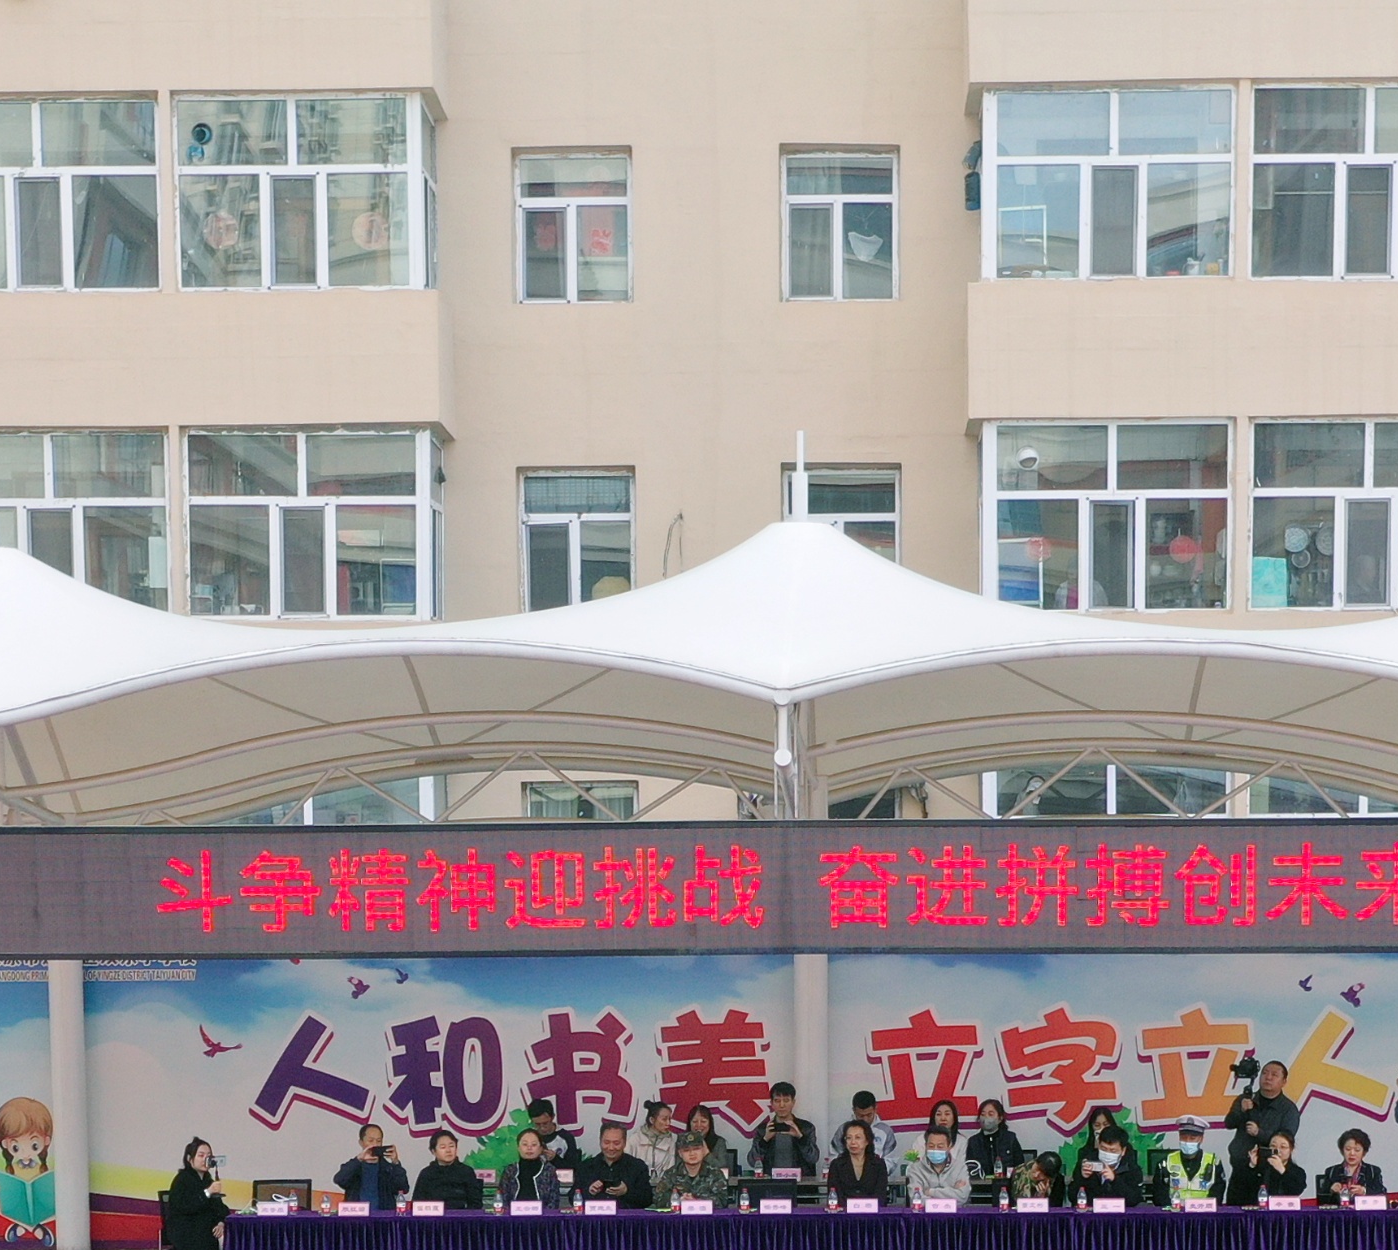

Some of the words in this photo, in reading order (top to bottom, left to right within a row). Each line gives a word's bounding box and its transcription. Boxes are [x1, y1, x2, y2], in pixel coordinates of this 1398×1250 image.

[156, 844, 765, 934] 斗争精神迎挑战
[251, 1008, 771, 1135] 人和书美
[867, 1005, 1393, 1134] 立字立人
